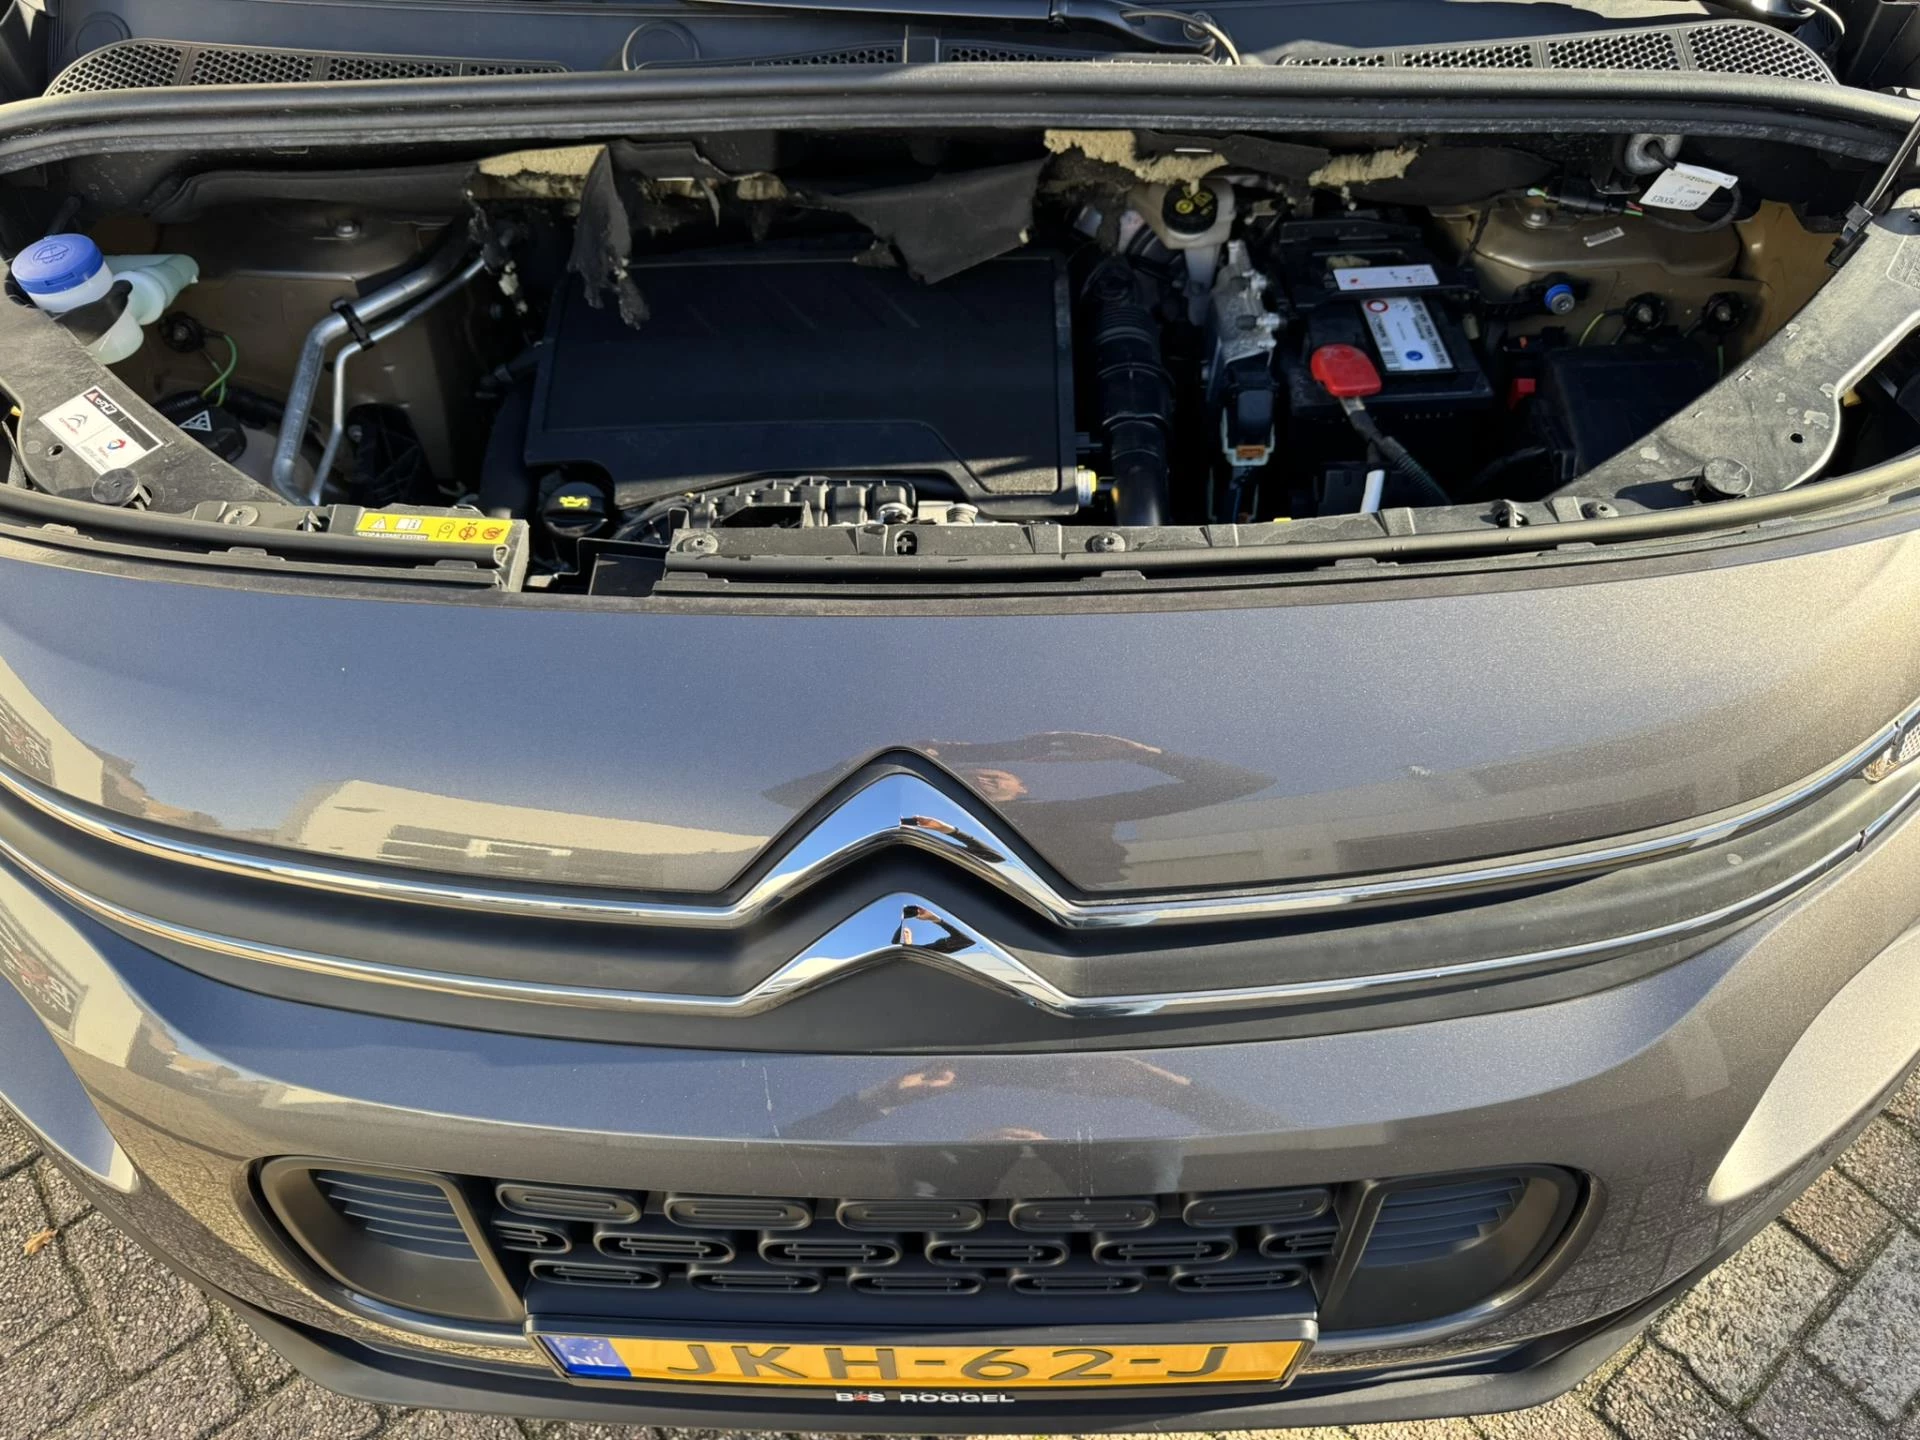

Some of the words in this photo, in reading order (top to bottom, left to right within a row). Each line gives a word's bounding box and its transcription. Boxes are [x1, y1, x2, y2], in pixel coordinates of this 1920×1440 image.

[567, 1354, 617, 1367] NL
[667, 1344, 1229, 1381] JKH-62-J
[900, 1393, 1016, 1403] ROGGEL
